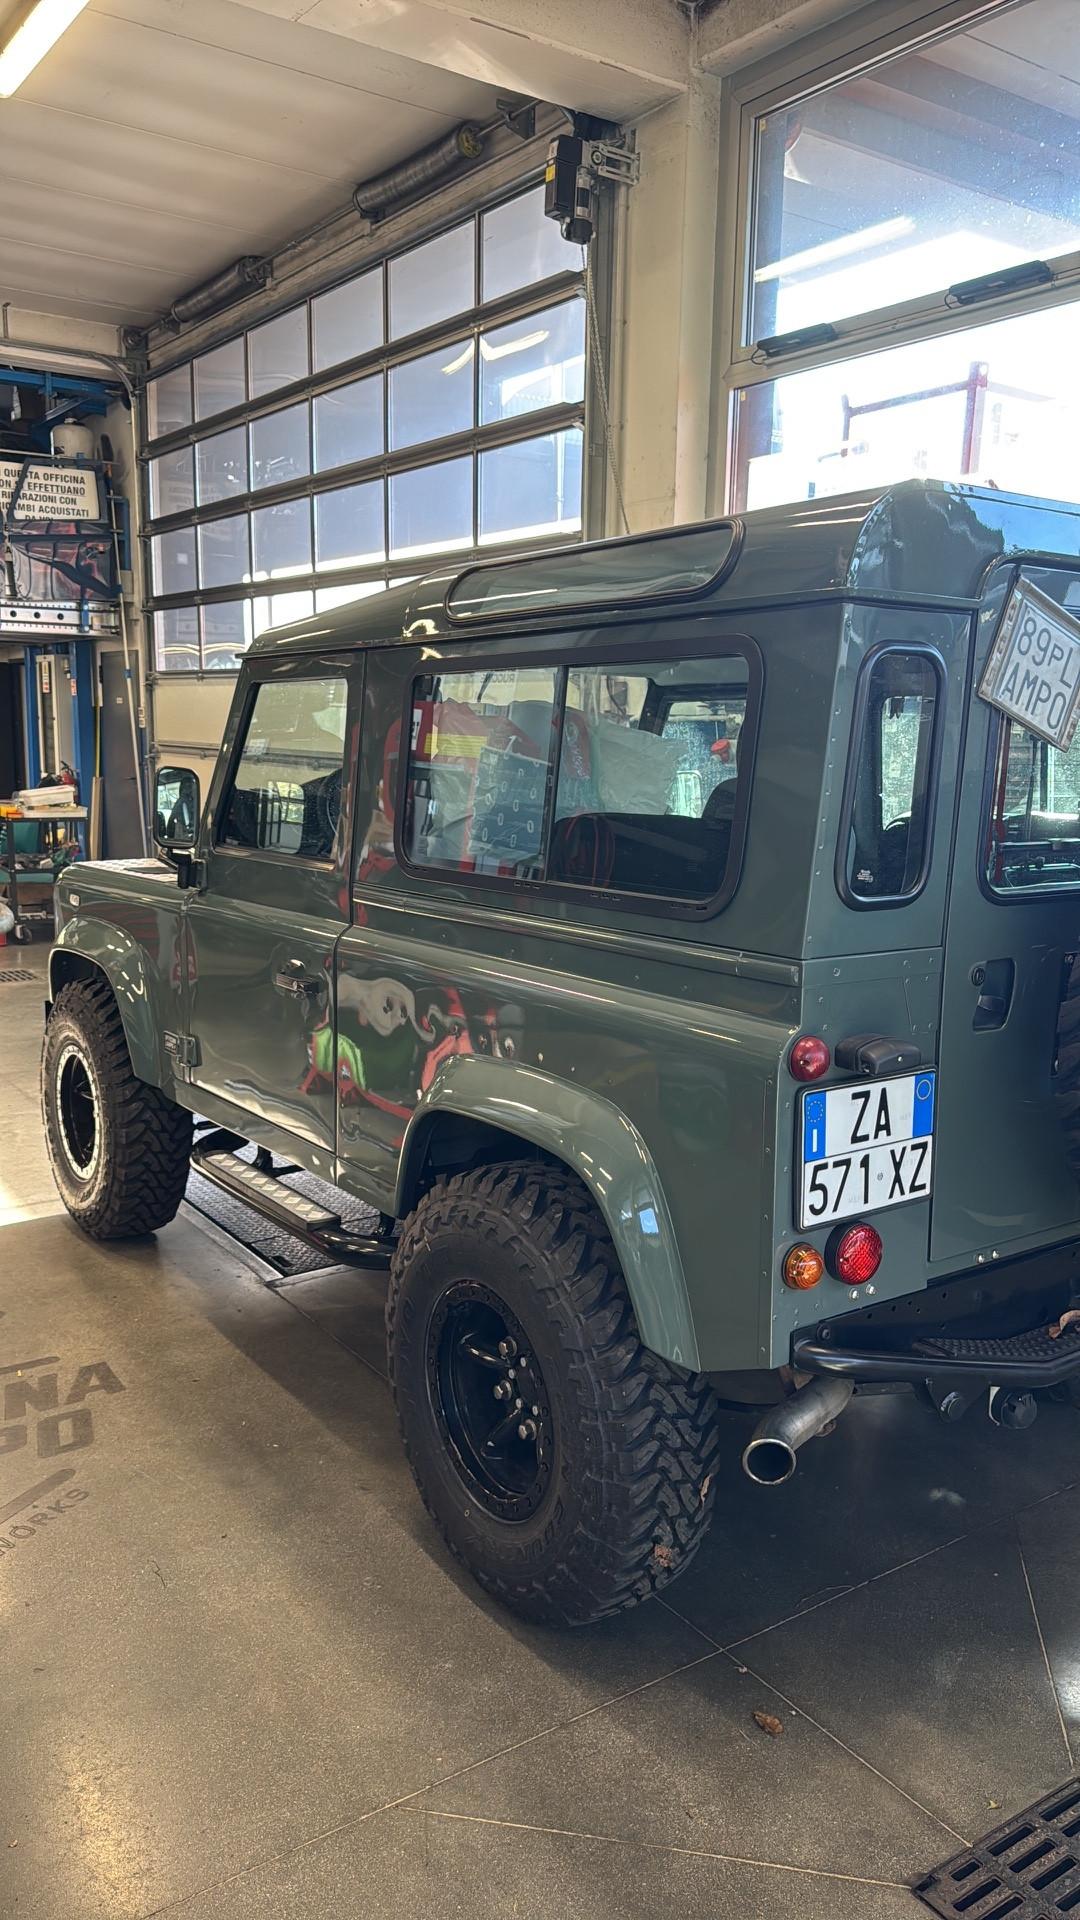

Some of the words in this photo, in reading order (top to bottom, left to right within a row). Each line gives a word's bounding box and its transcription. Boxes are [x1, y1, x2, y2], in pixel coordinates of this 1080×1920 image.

[4, 468, 40, 480] QUETA
[43, 473, 85, 485] OFFICINA
[27, 482, 85, 495] EFFETTUANO
[1, 490, 57, 504] RIRAZIONI
[59, 496, 77, 505] CON
[0, 501, 36, 513] ICMBI
[38, 504, 89, 518] ACQUISTATI
[1001, 662, 1067, 730] AMPO
[850, 1087, 892, 1145] ZA
[808, 1153, 870, 1216] 571
[888, 1140, 929, 1200] XZ
